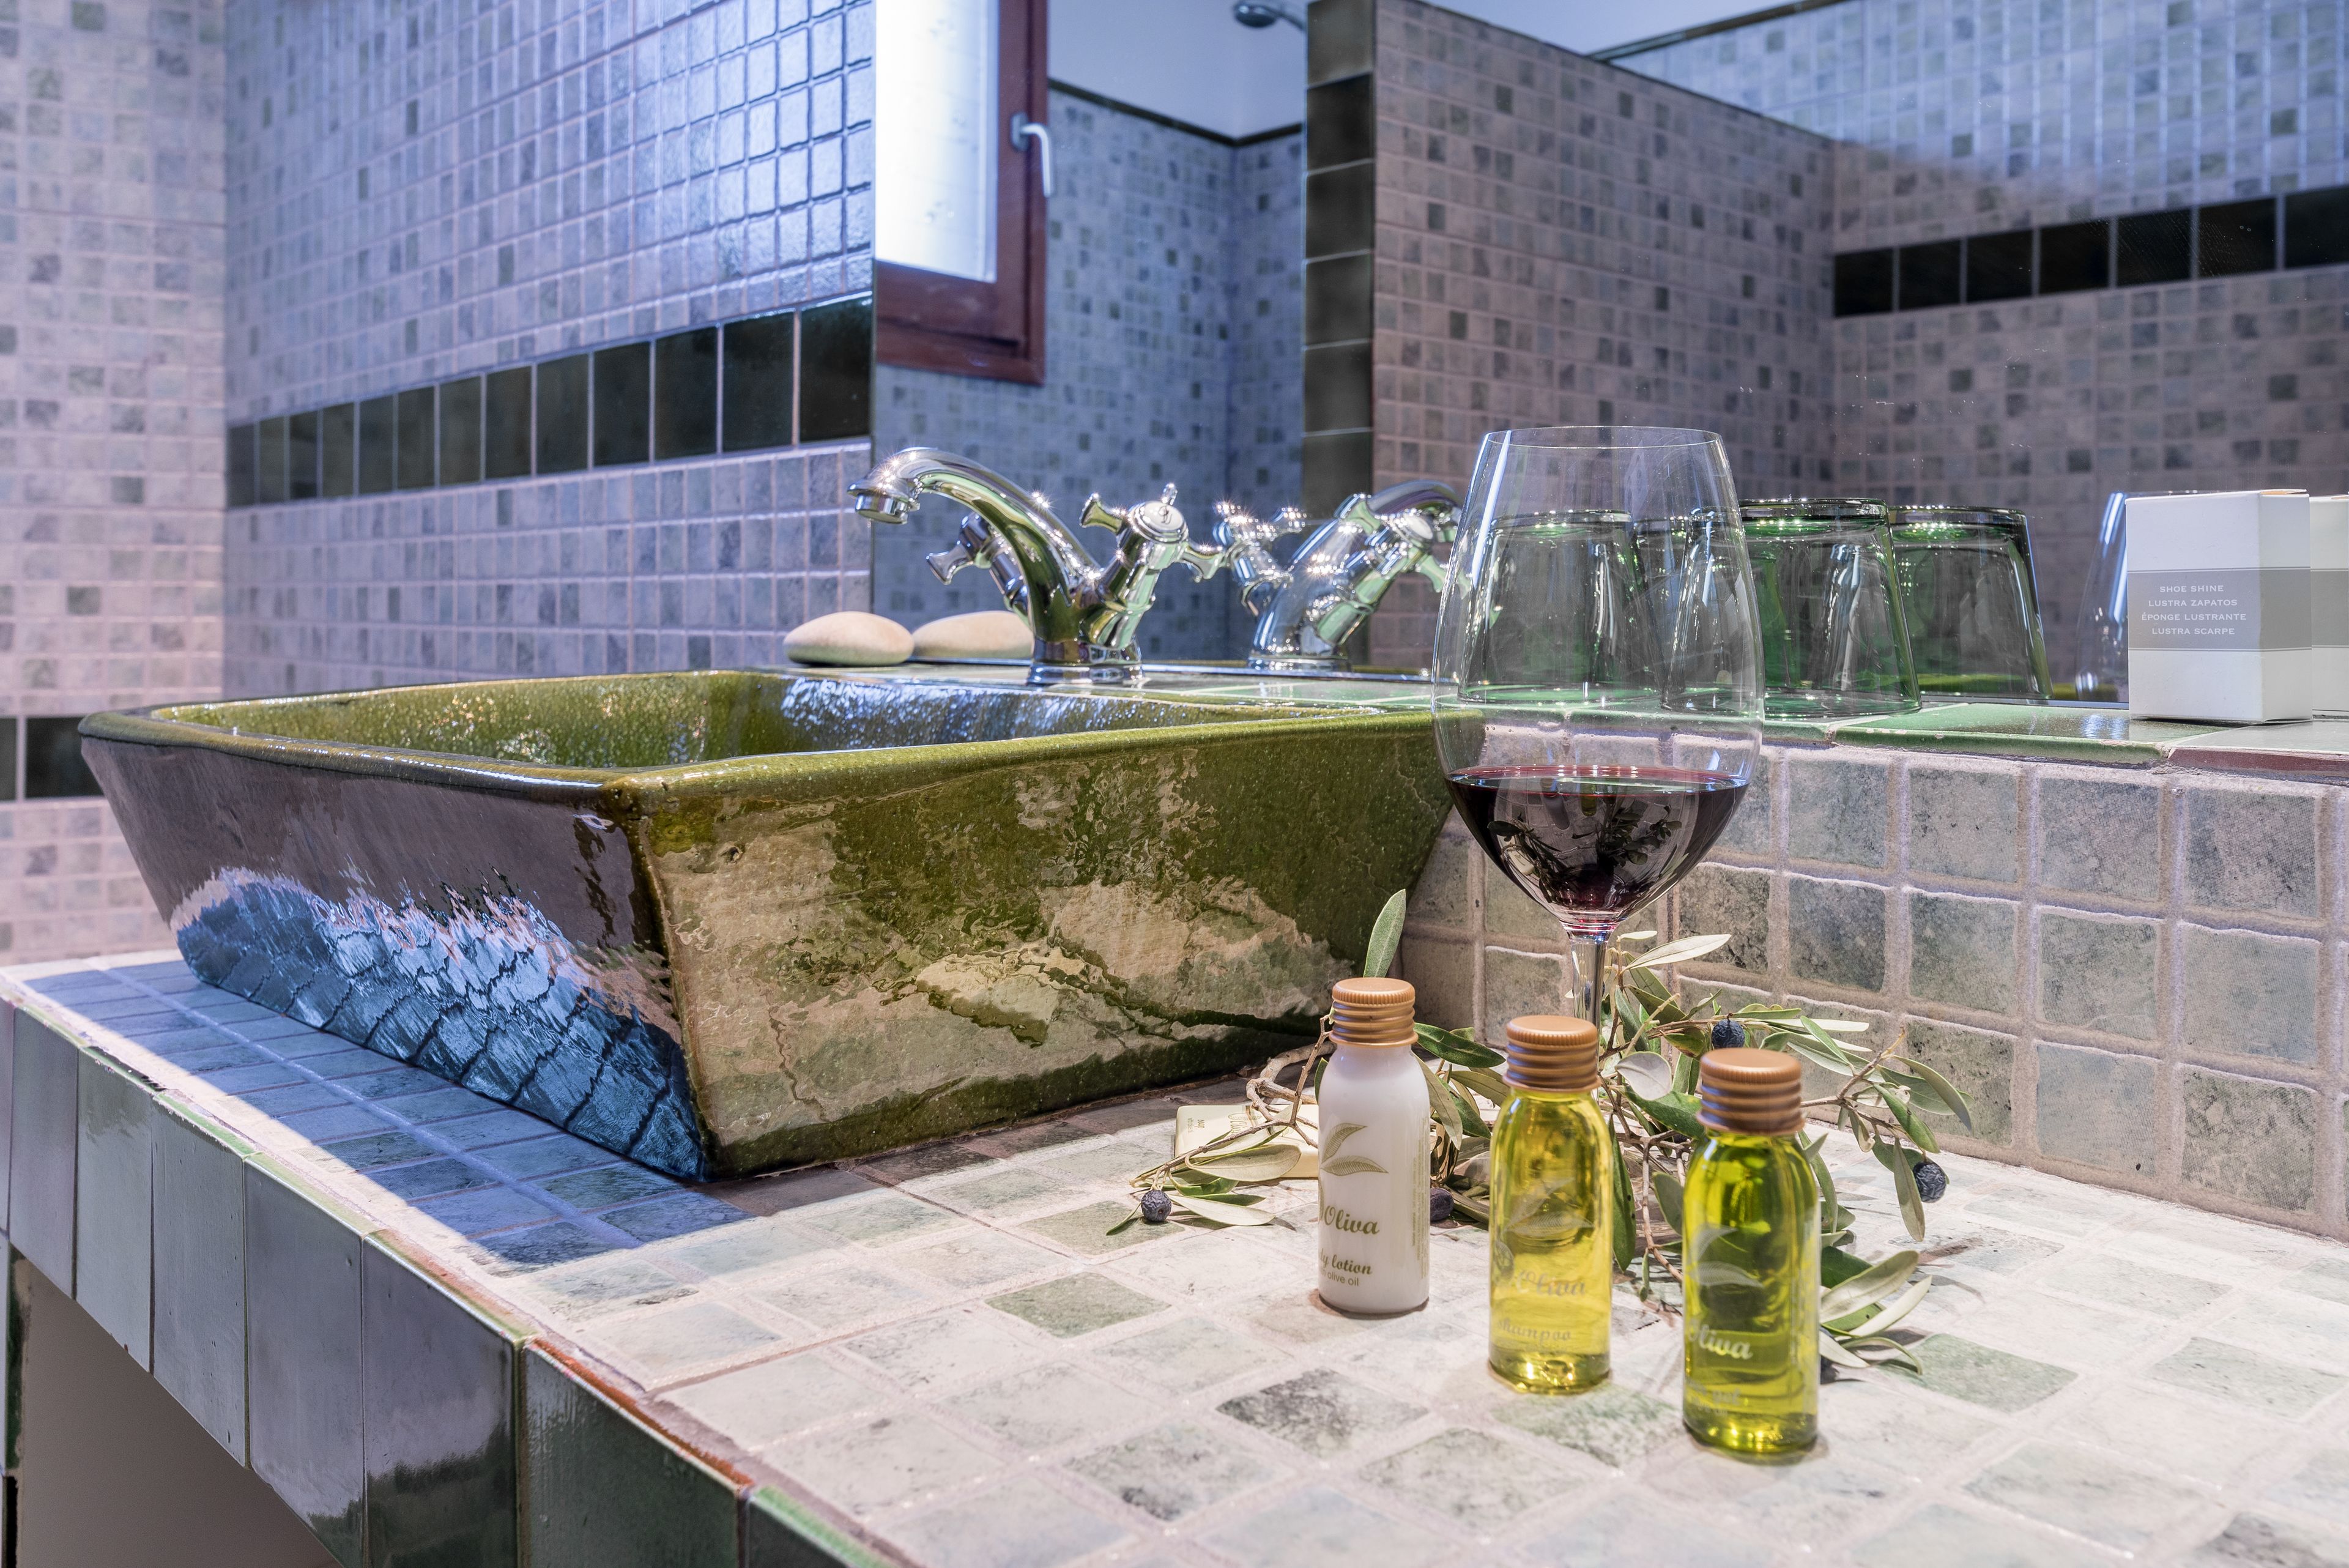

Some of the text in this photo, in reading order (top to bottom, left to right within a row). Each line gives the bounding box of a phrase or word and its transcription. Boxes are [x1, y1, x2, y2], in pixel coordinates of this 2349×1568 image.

[2141, 612, 2181, 621] ÉPONGE
[1324, 1205, 1380, 1235] Oliva
[1331, 1254, 1373, 1274] lotion
[1327, 1271, 1345, 1284] olive
[1348, 1277, 1359, 1286] oil
[1515, 1270, 1586, 1296] Oliva
[1688, 1318, 1754, 1360] Oliva
